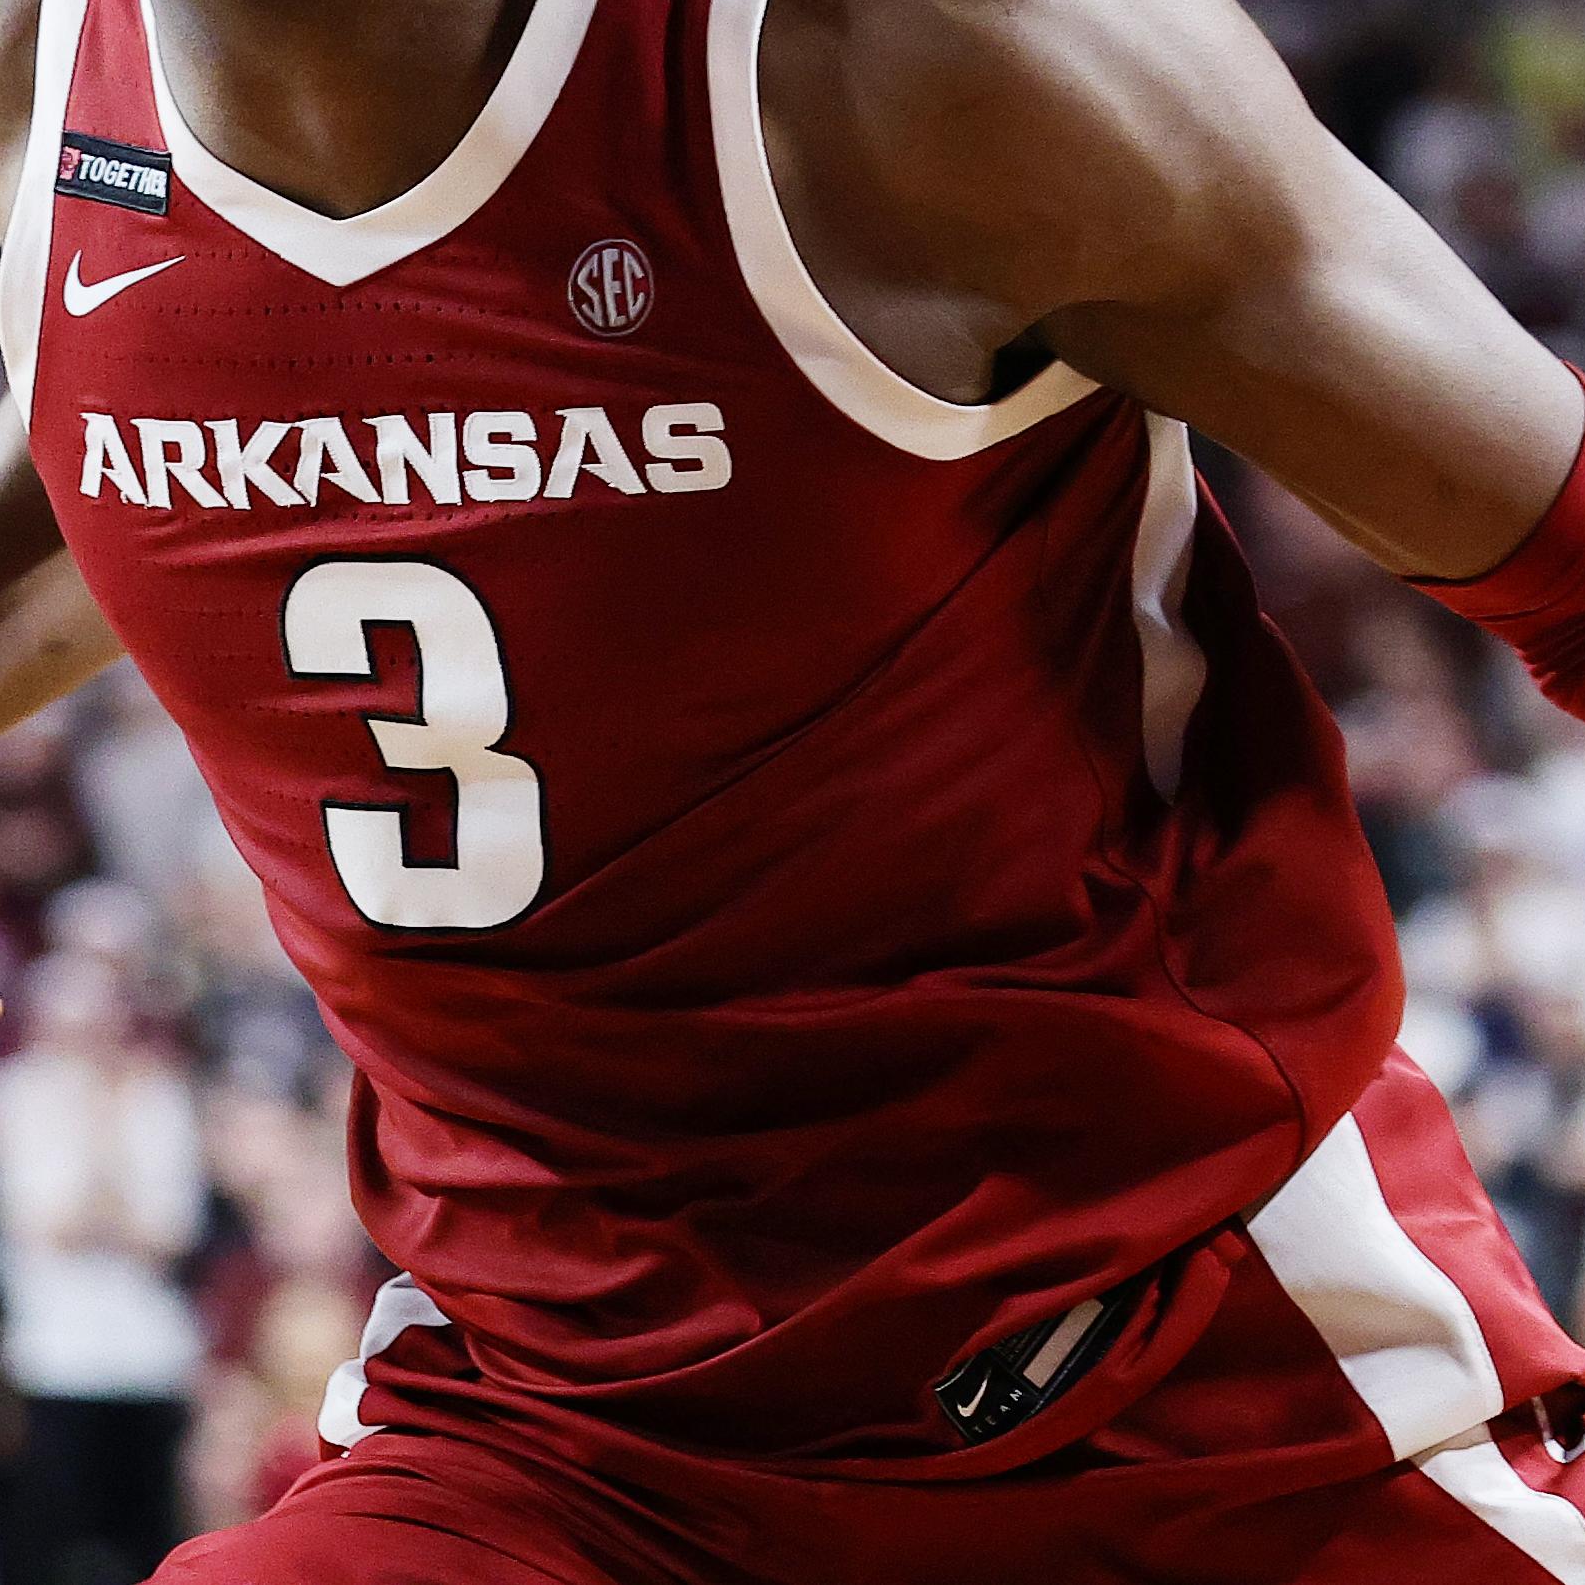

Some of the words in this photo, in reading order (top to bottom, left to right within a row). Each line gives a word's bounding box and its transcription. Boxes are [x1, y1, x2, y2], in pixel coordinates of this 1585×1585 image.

[576, 248, 646, 328] SEC
[79, 402, 733, 510] ARKANSAS
[280, 554, 551, 934] 3
